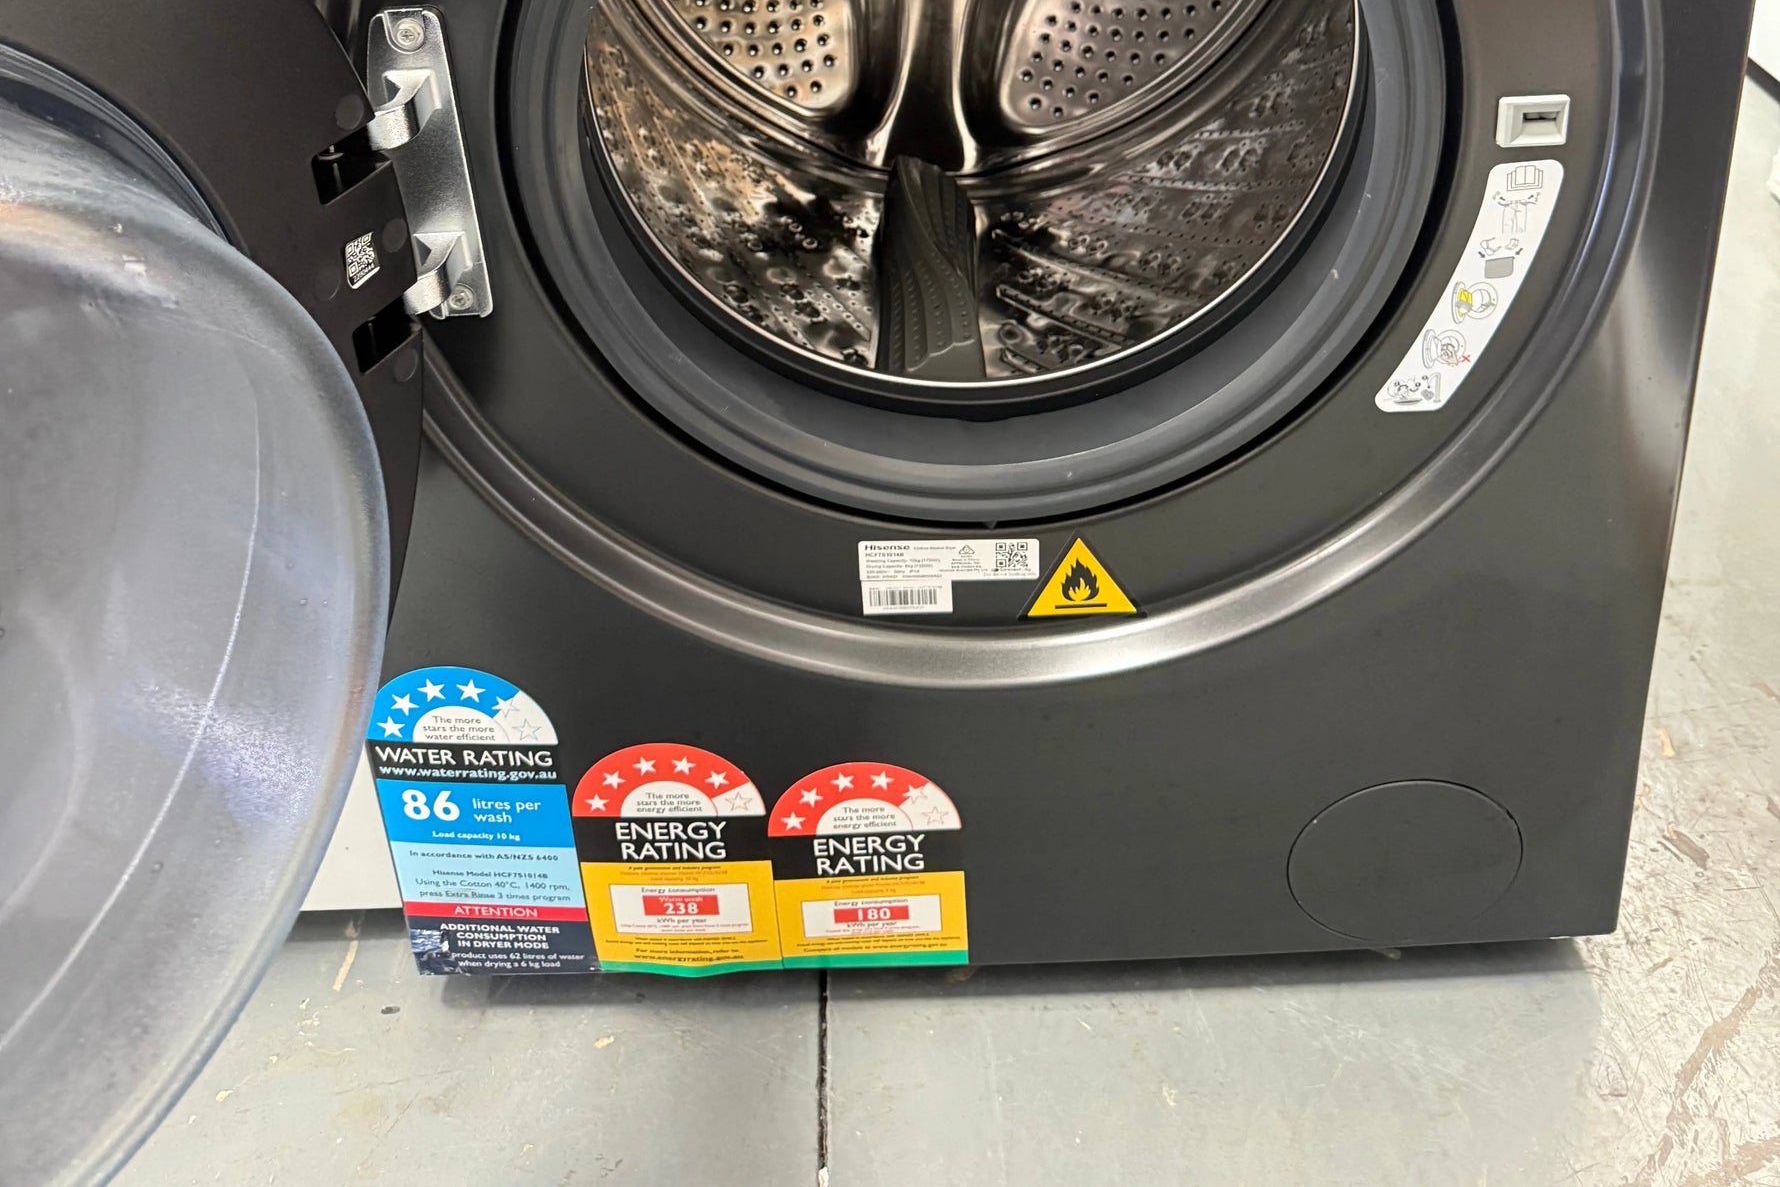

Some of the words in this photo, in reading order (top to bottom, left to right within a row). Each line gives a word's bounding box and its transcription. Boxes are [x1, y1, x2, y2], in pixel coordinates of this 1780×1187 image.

[433, 716, 452, 724] The
[456, 733, 496, 741] efficient
[375, 746, 456, 765] WATER
[463, 750, 553, 767] RATING
[379, 765, 557, 781] www.waterrating.gov.au
[402, 789, 460, 821] 86
[472, 798, 511, 810] litres
[516, 801, 541, 812] per
[474, 812, 512, 823] wash
[457, 832, 494, 840] capacity
[509, 833, 520, 841] kg
[615, 821, 727, 841] ENERGY
[813, 834, 925, 857] ENERGY
[421, 851, 472, 859] accordance
[621, 842, 726, 861] RATING
[816, 853, 925, 876] RATING
[415, 878, 440, 887] Using
[443, 879, 457, 887] the
[459, 879, 492, 888] Cotton
[454, 906, 538, 918] ATTENTION
[664, 902, 698, 914] 238
[858, 908, 891, 921] 180
[440, 923, 514, 932] ADDITIONAL
[517, 925, 560, 934] WATER
[456, 932, 546, 941] CONSUMPTION
[468, 941, 512, 949] DRYER
[514, 942, 549, 950] MODE
[451, 952, 486, 960] product
[484, 961, 511, 970] drying
[528, 961, 540, 969] kg
